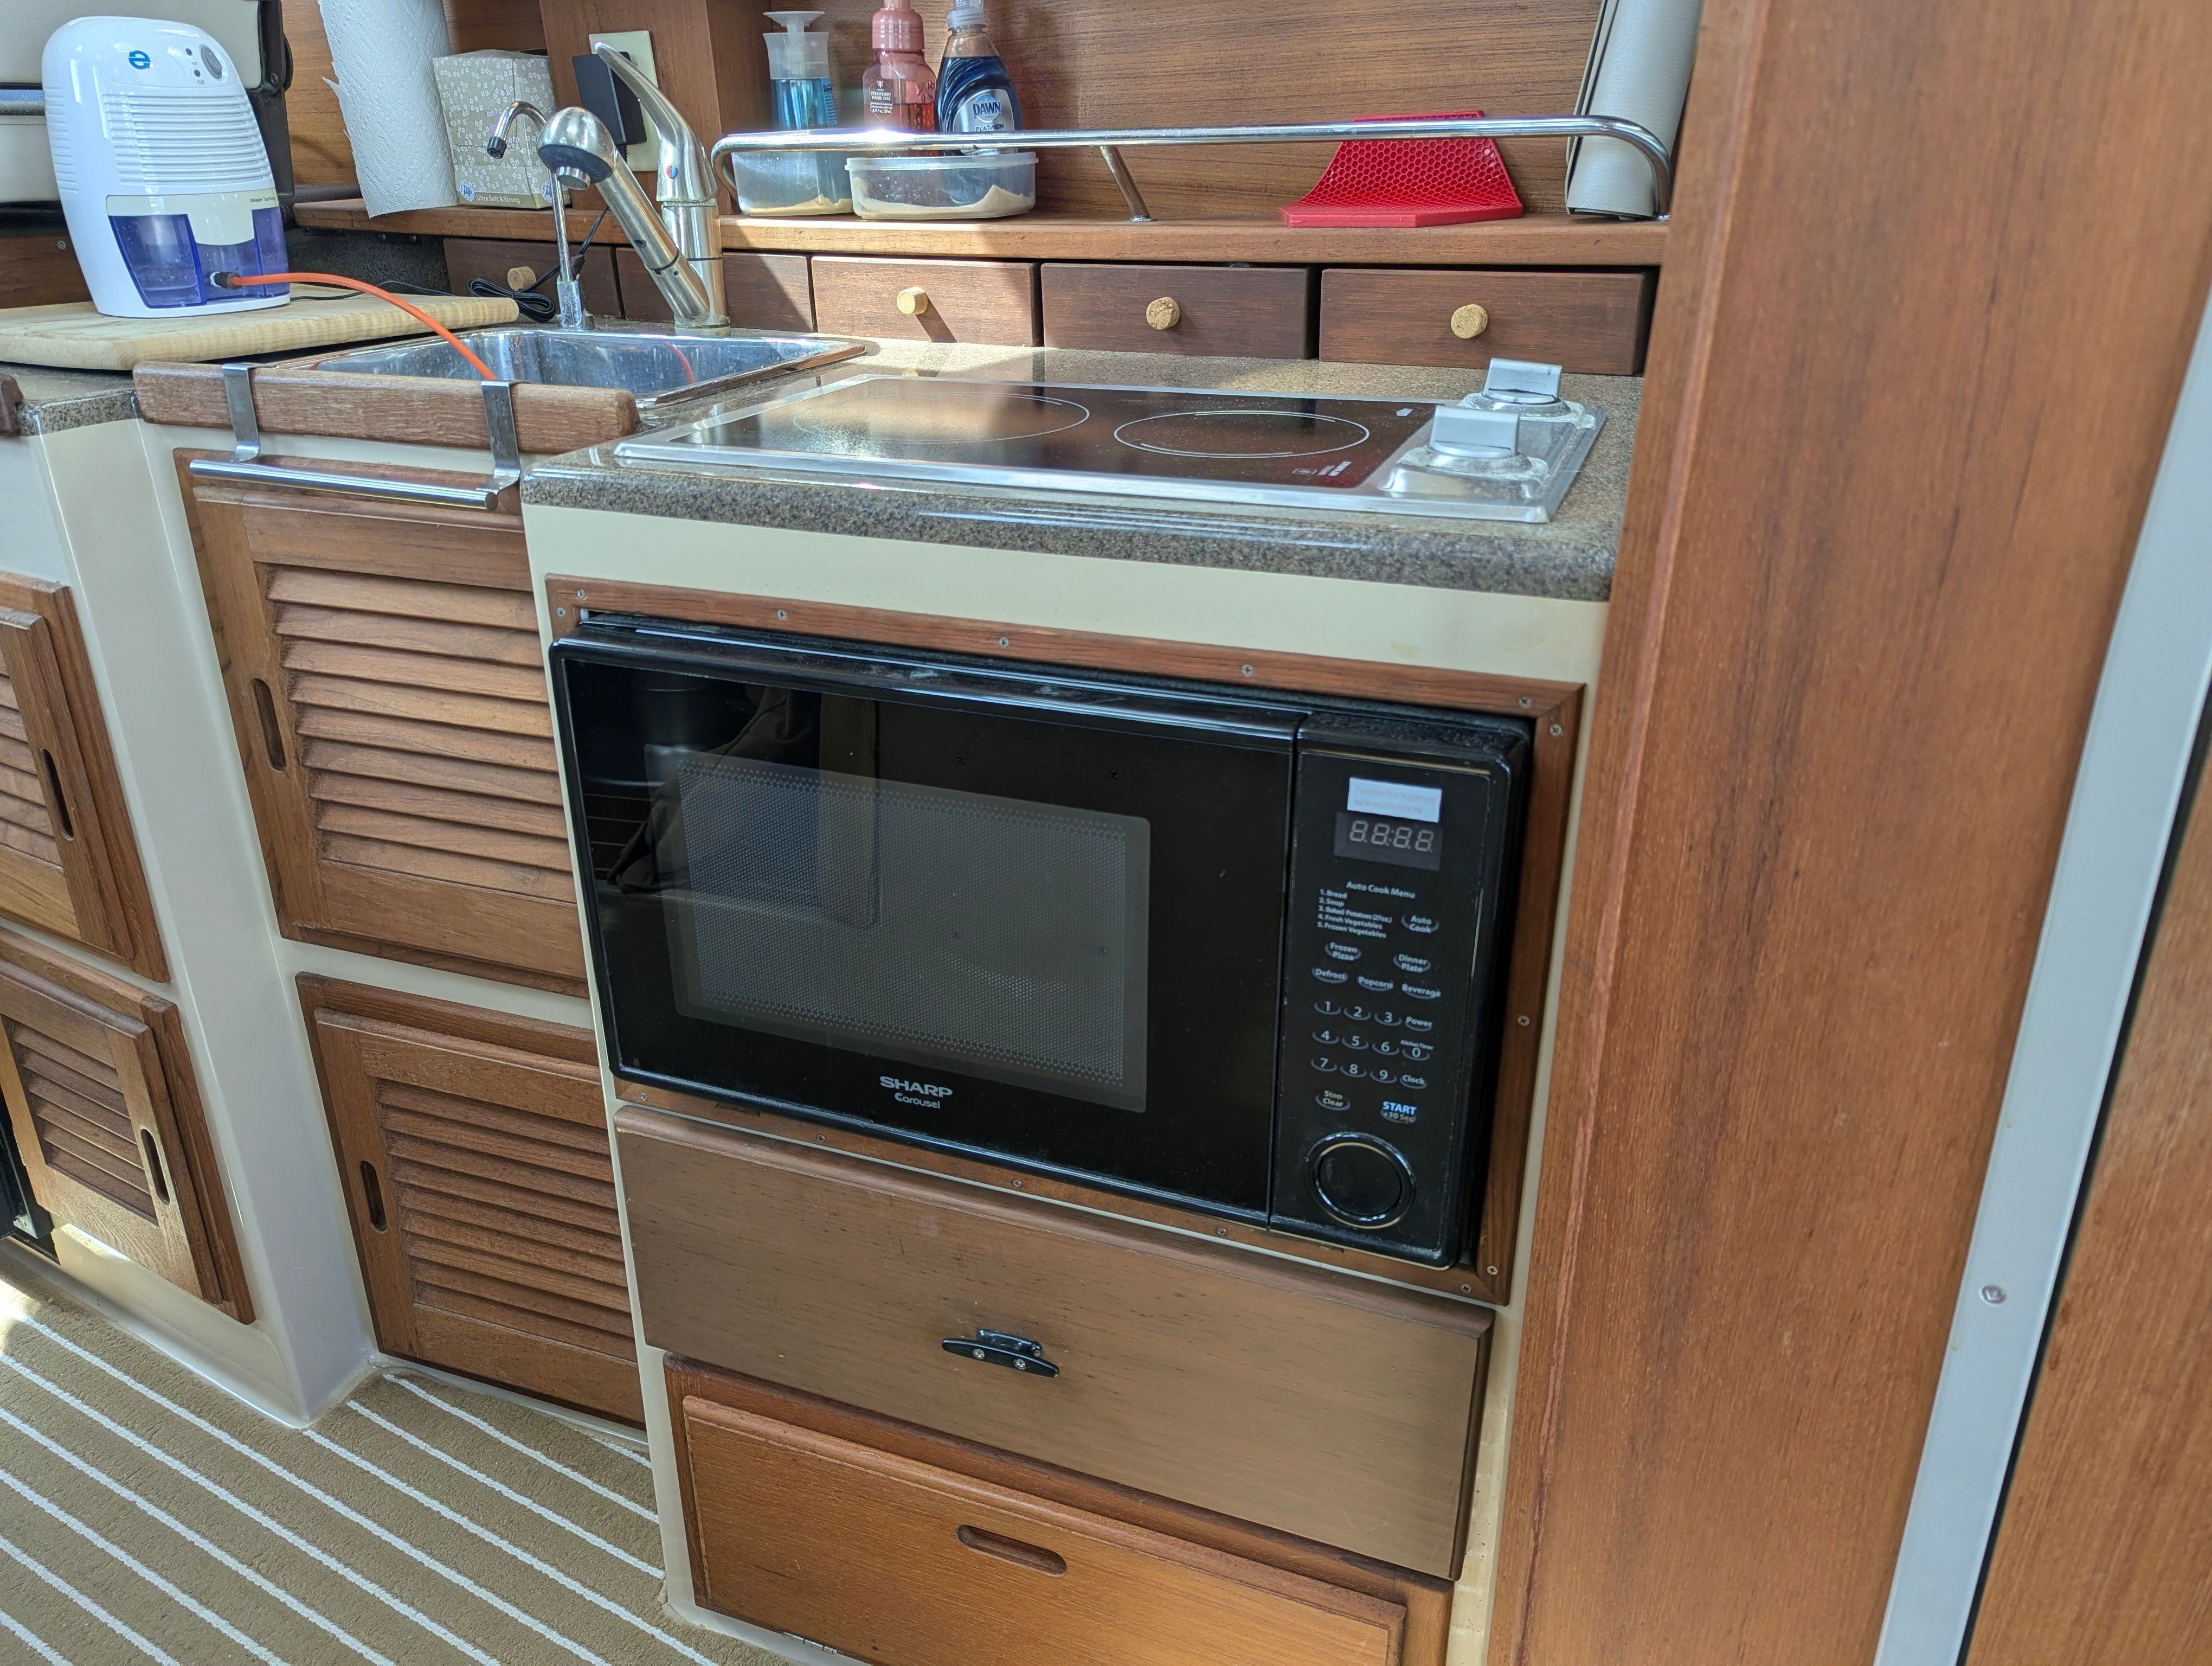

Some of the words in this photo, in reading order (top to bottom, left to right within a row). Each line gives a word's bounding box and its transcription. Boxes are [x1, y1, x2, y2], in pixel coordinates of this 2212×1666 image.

[973, 101, 1001, 116] DAWN
[975, 124, 1004, 132] PLATINUM
[1326, 889, 1348, 899] Bread
[1346, 881, 1367, 892] Auto
[1368, 884, 1390, 895] Cook
[1391, 887, 1416, 899] Menu
[1326, 898, 1345, 907] Soup
[1345, 909, 1372, 920] Potatoes
[1410, 915, 1432, 925] Auto
[1324, 914, 1344, 923] Fresh
[1344, 918, 1383, 930] Vegetables
[1324, 922, 1348, 932] Frozen
[1348, 926, 1387, 939] Vegetables
[1410, 923, 1432, 934] Cook
[1330, 942, 1358, 953] Frozen
[1333, 951, 1354, 961] Pizza
[1398, 953, 1427, 965] Dinner
[1315, 968, 1346, 979] Defrost
[1401, 963, 1423, 973] Plate
[1358, 976, 1393, 989] Popcorn
[1401, 983, 1441, 998] Beverage
[1325, 1001, 1330, 1011] 1
[1353, 1006, 1362, 1017] 2
[1384, 1011, 1393, 1023] 3
[1406, 1016, 1432, 1027] Power
[1321, 1030, 1330, 1041] 4
[1351, 1035, 1360, 1046] 5
[1381, 1041, 1390, 1052] 6
[1412, 1047, 1421, 1058] 0
[1320, 1058, 1328, 1068] 7
[1349, 1063, 1358, 1074] 8
[1379, 1069, 1388, 1080] 9
[1402, 1074, 1425, 1085] Clock
[879, 1076, 953, 1098] SHARP
[895, 1092, 941, 1109] Carousel
[1324, 1090, 1343, 1100] Stop
[1322, 1098, 1343, 1107] Clear
[1382, 1101, 1417, 1115] START
